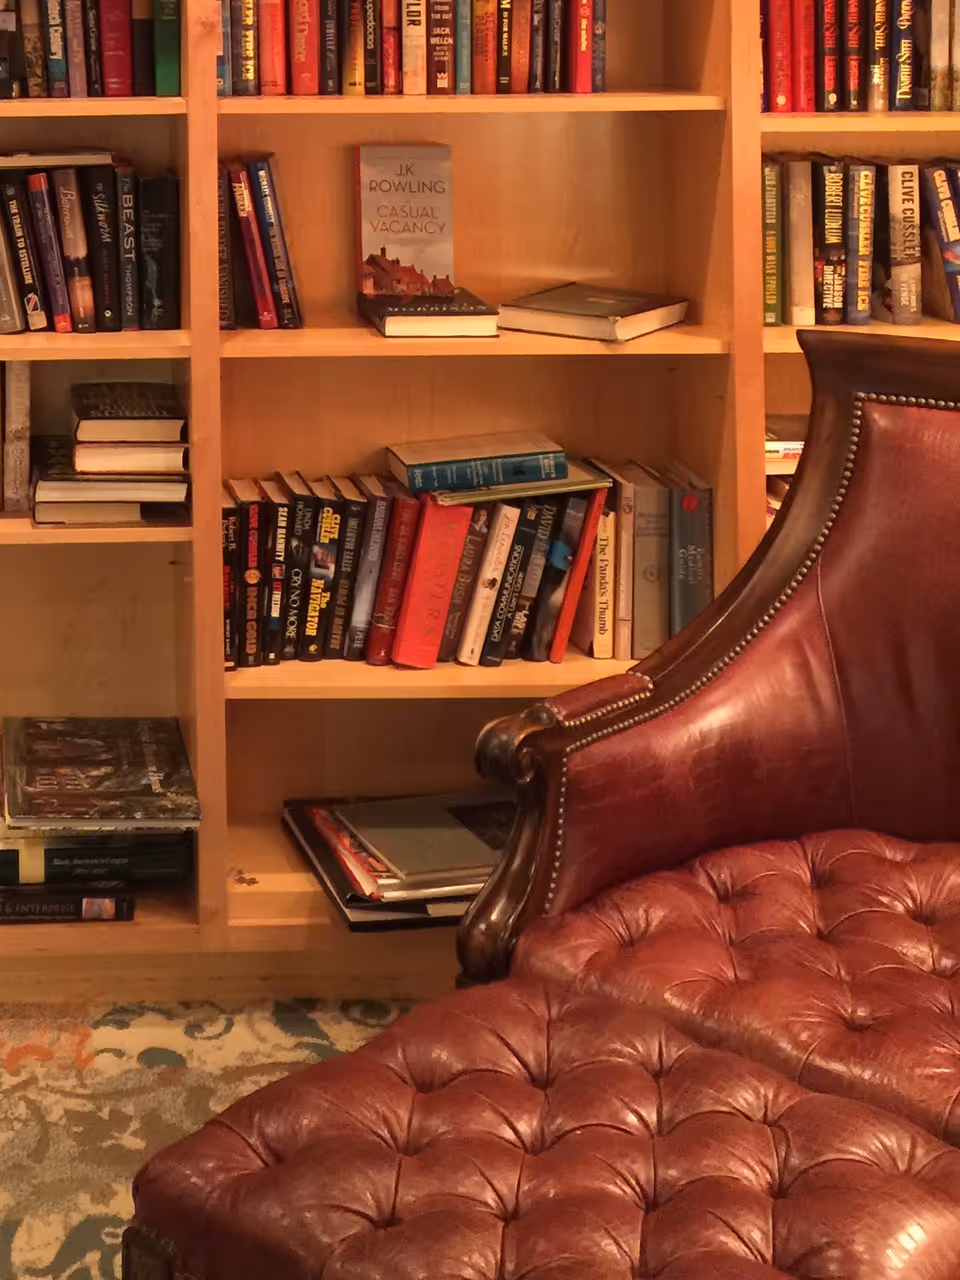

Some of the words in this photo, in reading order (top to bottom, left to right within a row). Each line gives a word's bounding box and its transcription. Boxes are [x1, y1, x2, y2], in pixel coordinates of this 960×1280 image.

[49, 26, 62, 59] Century
[242, 30, 253, 58] FIRE
[874, 24, 888, 50] STEEL
[241, 60, 253, 80] ICE
[122, 176, 130, 193] The
[232, 183, 248, 217] PARKER
[369, 180, 445, 193] ROWLING
[826, 173, 842, 206] ROBERT
[859, 171, 872, 205] CLIVE
[901, 171, 915, 204] CLIVE
[10, 200, 19, 214] THE
[376, 205, 439, 219] CASUAL
[13, 215, 22, 236] TRAIN
[122, 194, 135, 262] BEAST
[370, 221, 446, 234] VACANCY
[826, 209, 842, 244] LUDLUM
[859, 206, 870, 255] CUSSLER
[902, 208, 915, 259] CUSSLER
[16, 238, 25, 248] TO
[19, 250, 32, 284] ESTELLINE
[858, 260, 870, 288] FIRE
[125, 265, 133, 315] THOMPSON
[823, 265, 833, 308] DIRECTIVE
[858, 291, 869, 311] ICE
[228, 516, 236, 541] Robert
[295, 501, 303, 536] HOWARD
[304, 508, 312, 529] LINDA
[321, 507, 333, 543] CUSSLER
[332, 514, 340, 539] CLIVE
[538, 504, 555, 539] DAVID
[228, 543, 236, 551] B.
[459, 535, 479, 573] LAURA
[599, 536, 610, 556] The
[291, 568, 302, 588] CRY
[598, 559, 609, 597] Panda's
[678, 549, 687, 580] Guide
[687, 545, 697, 584] Medical
[453, 573, 470, 605] BUSH
[497, 545, 522, 619] COMMUNICATIONS
[290, 590, 300, 607] NO
[306, 578, 324, 636] NAVIGATOR
[321, 592, 330, 608] The
[285, 609, 300, 639] MORE
[491, 619, 505, 642] DATA
[598, 599, 610, 635] Thumb
